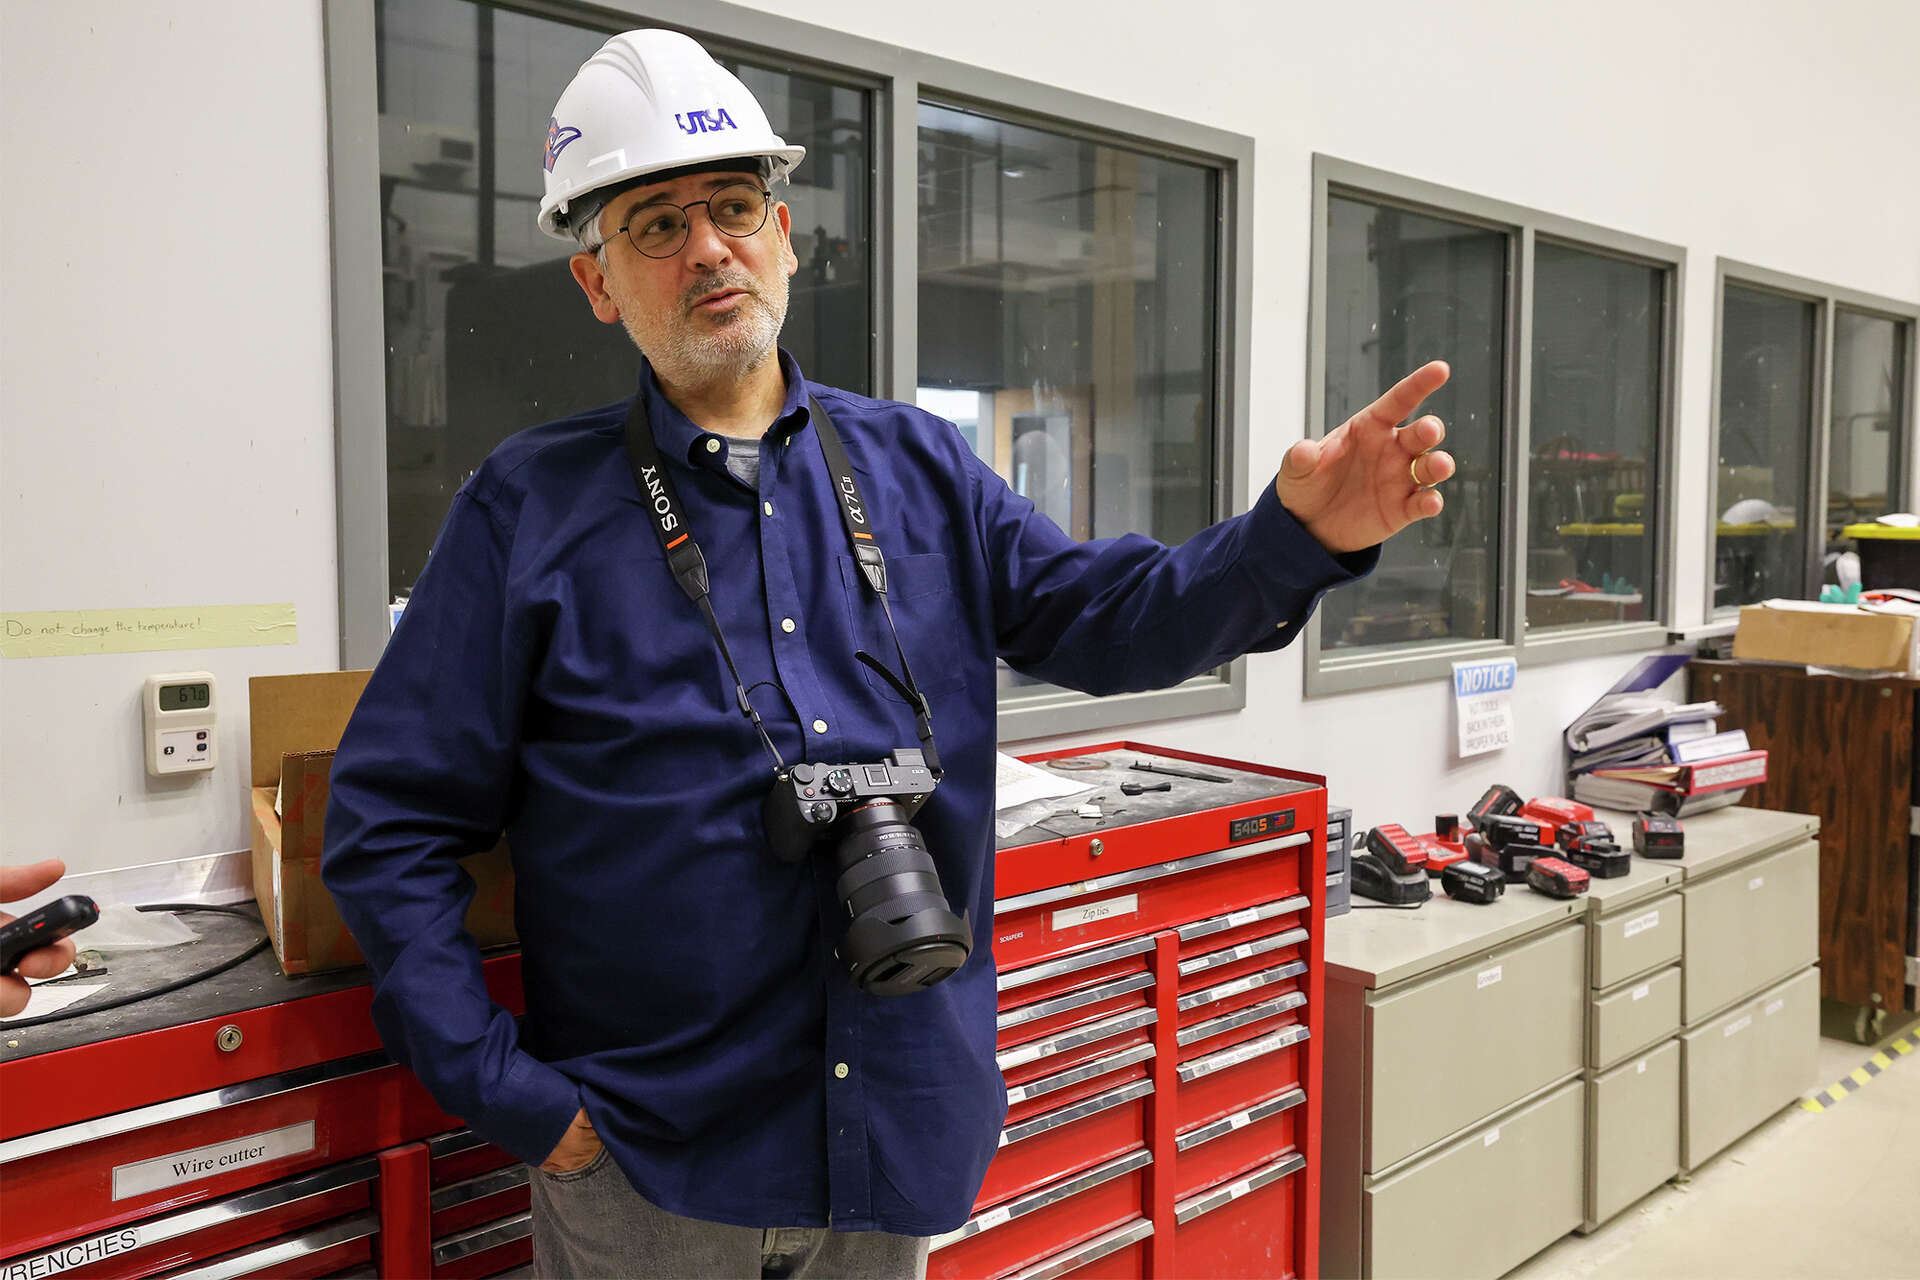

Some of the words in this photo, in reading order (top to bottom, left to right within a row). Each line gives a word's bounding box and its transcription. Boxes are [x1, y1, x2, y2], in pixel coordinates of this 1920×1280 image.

[675, 108, 738, 135] UTSA
[641, 465, 679, 532] SONY
[6, 619, 32, 637] Do
[41, 622, 64, 634] not
[72, 623, 110, 637] change
[115, 620, 133, 632] the
[1462, 664, 1511, 692] NOTICE
[1082, 908, 1095, 921] Zip
[172, 1159, 214, 1177] Wire
[219, 1145, 265, 1167] cutter
